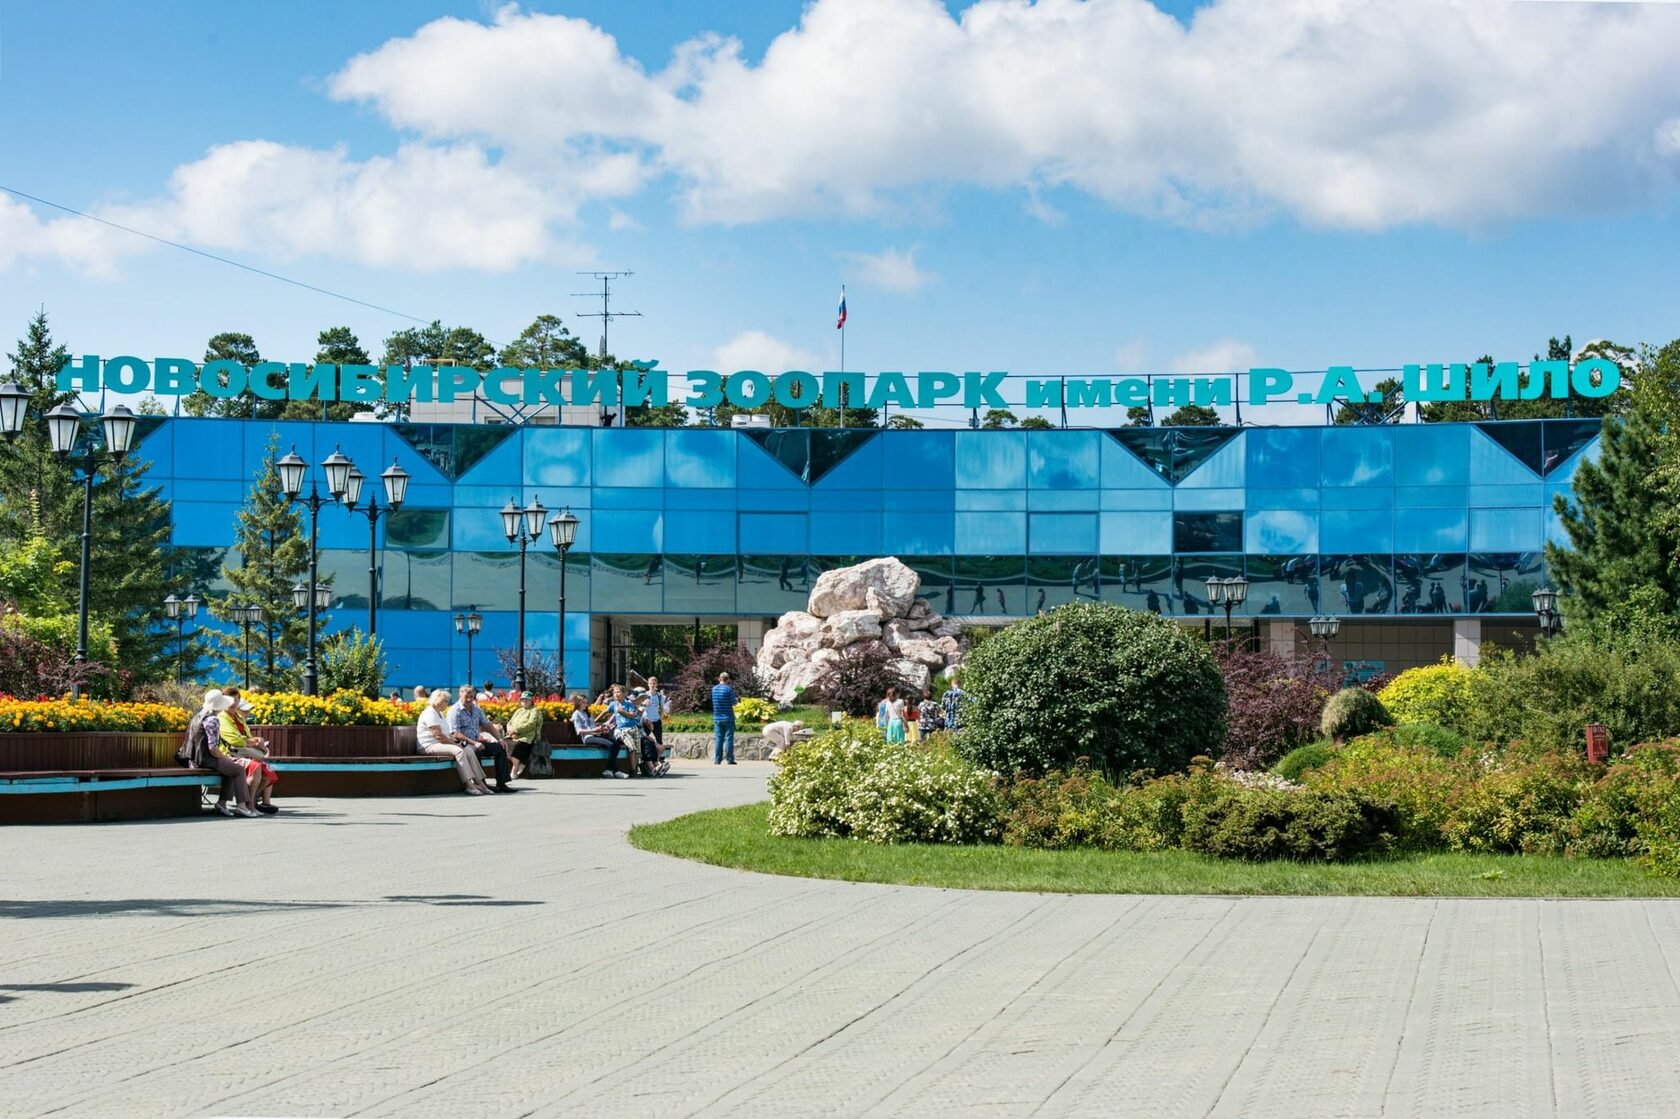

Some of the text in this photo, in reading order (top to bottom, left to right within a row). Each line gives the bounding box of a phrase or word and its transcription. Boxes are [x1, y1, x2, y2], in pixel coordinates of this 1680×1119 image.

[56, 355, 669, 408] НОВОСИБИРСКИЙ
[686, 371, 1008, 410] ЗООПАРК
[1025, 378, 1231, 408] имени
[1402, 358, 1621, 402] ШИЛО
